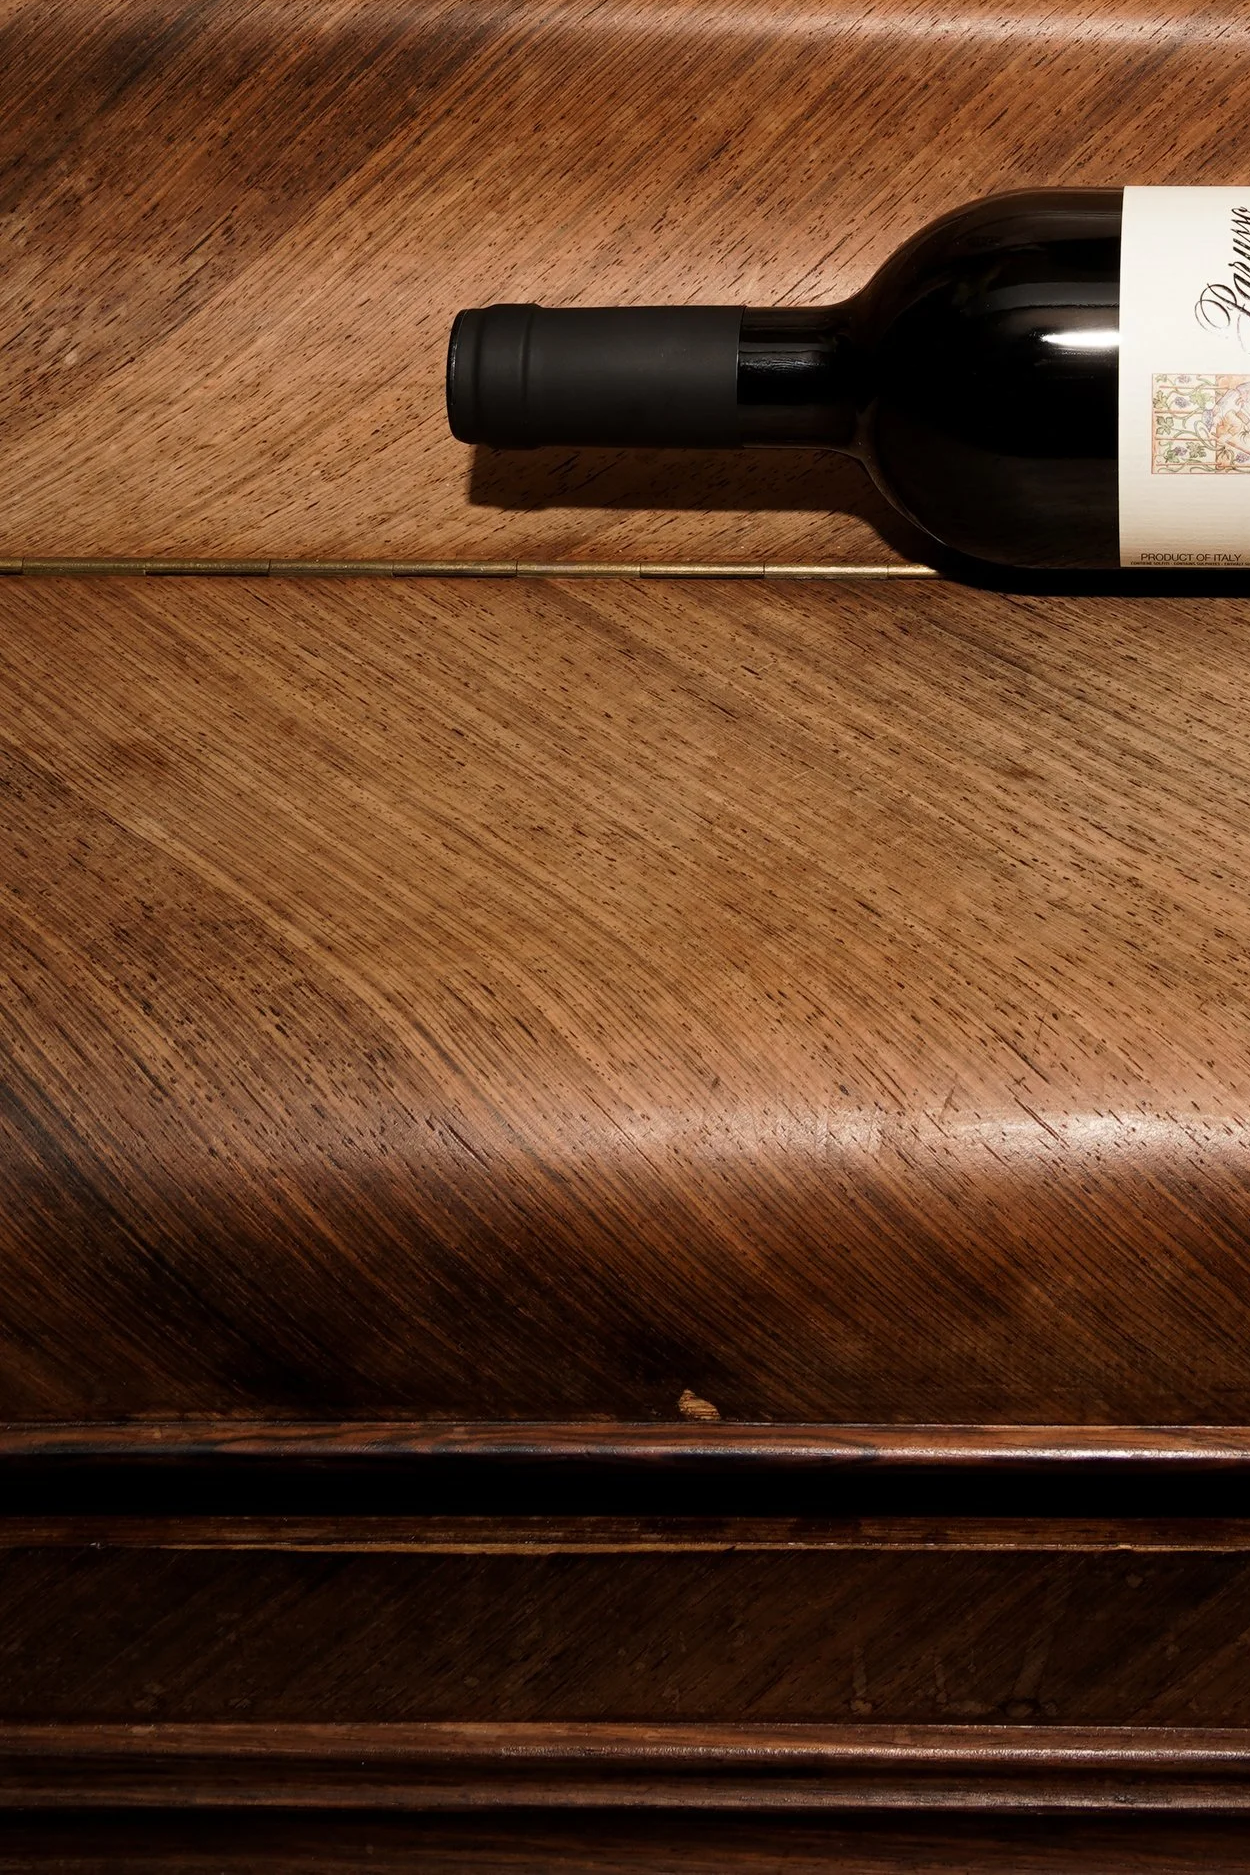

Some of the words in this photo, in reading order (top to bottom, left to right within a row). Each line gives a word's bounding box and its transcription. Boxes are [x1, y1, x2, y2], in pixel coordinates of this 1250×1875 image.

[1140, 553, 1194, 562] PRODUCT
[1196, 553, 1211, 562] OF
[1214, 554, 1242, 562] ITALY
